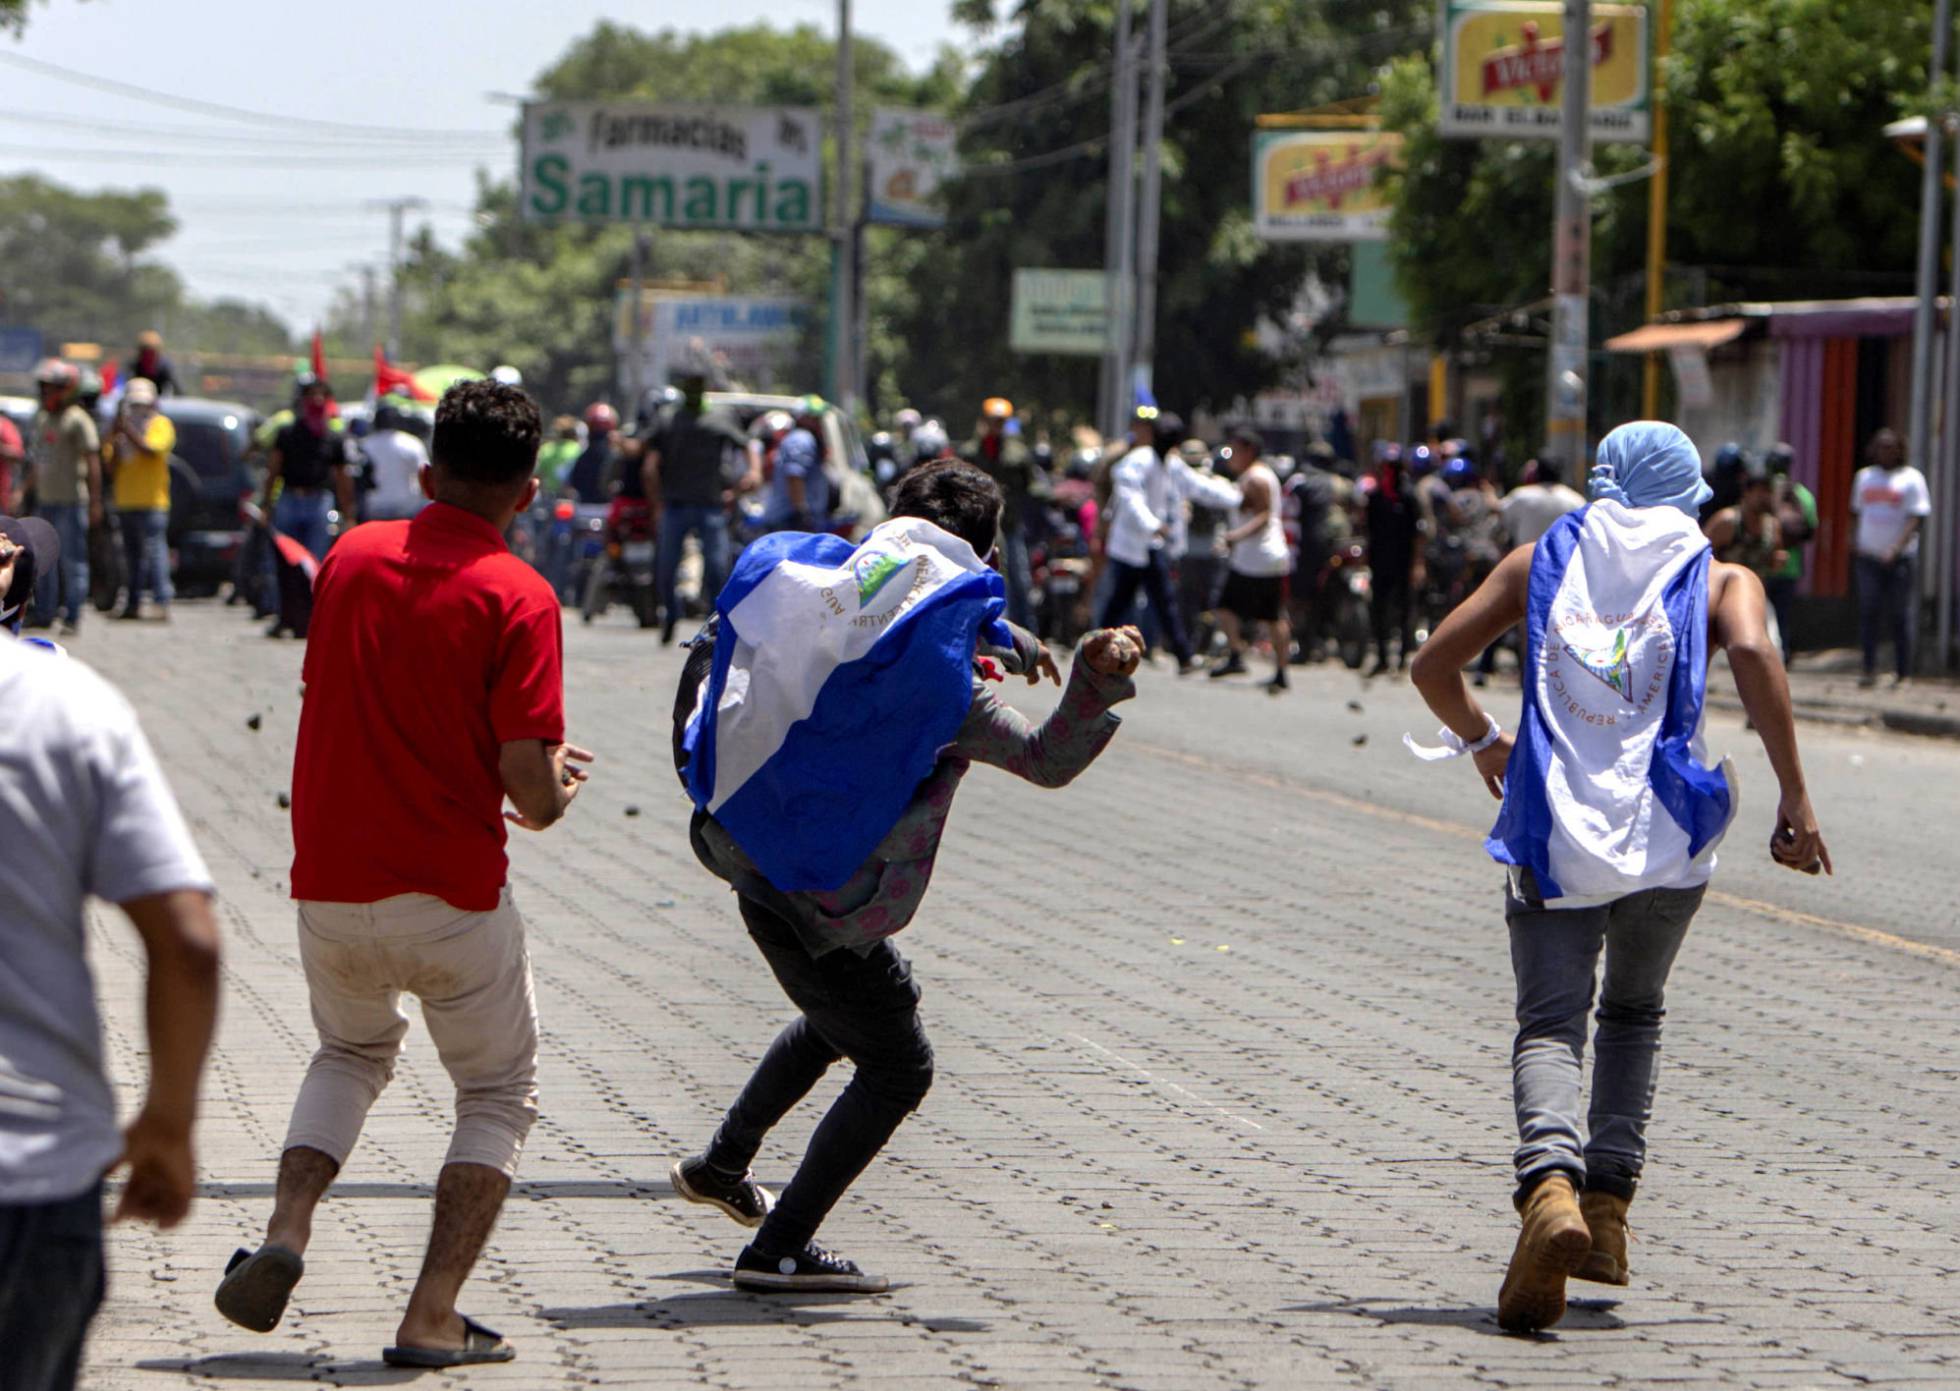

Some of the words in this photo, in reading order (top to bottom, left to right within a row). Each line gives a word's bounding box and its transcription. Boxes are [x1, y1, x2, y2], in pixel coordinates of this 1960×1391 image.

[530, 153, 812, 223] Samaria
[1548, 643, 1560, 662] DE
[1637, 643, 1669, 714] AMERICA
[1549, 669, 1617, 726] REPUBLICA
